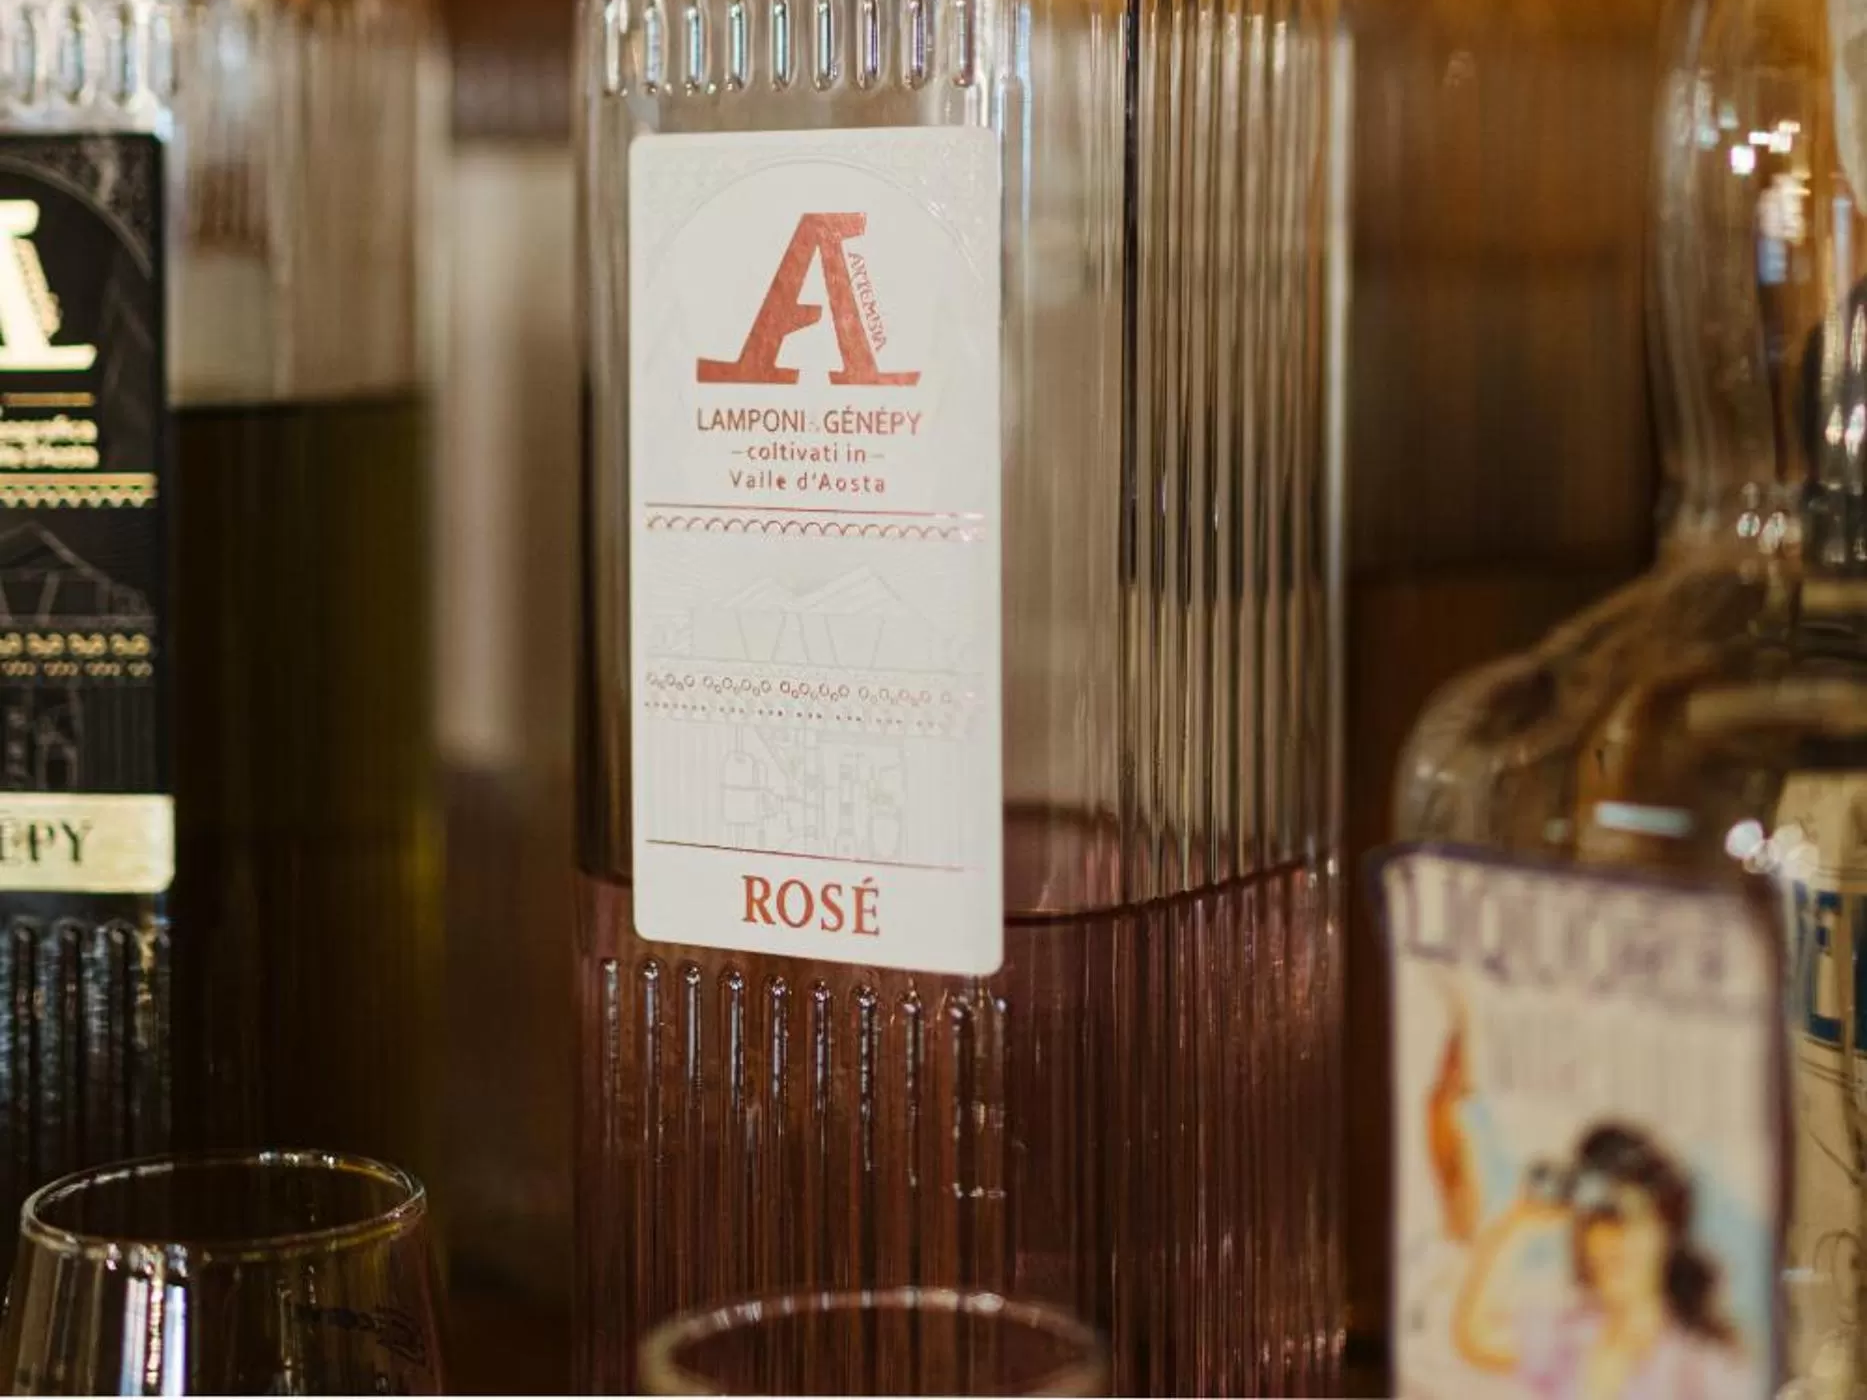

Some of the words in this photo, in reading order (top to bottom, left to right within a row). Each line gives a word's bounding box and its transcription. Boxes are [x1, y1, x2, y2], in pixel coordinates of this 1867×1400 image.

[696, 212, 921, 386] A
[696, 407, 805, 433] LAMPONI
[823, 406, 922, 435] GÉNÉPY
[747, 441, 838, 462] coltivati
[846, 443, 866, 463] in
[730, 470, 787, 490] Valle
[797, 472, 885, 493] d'Aosta
[741, 875, 880, 936] ROSÉ
